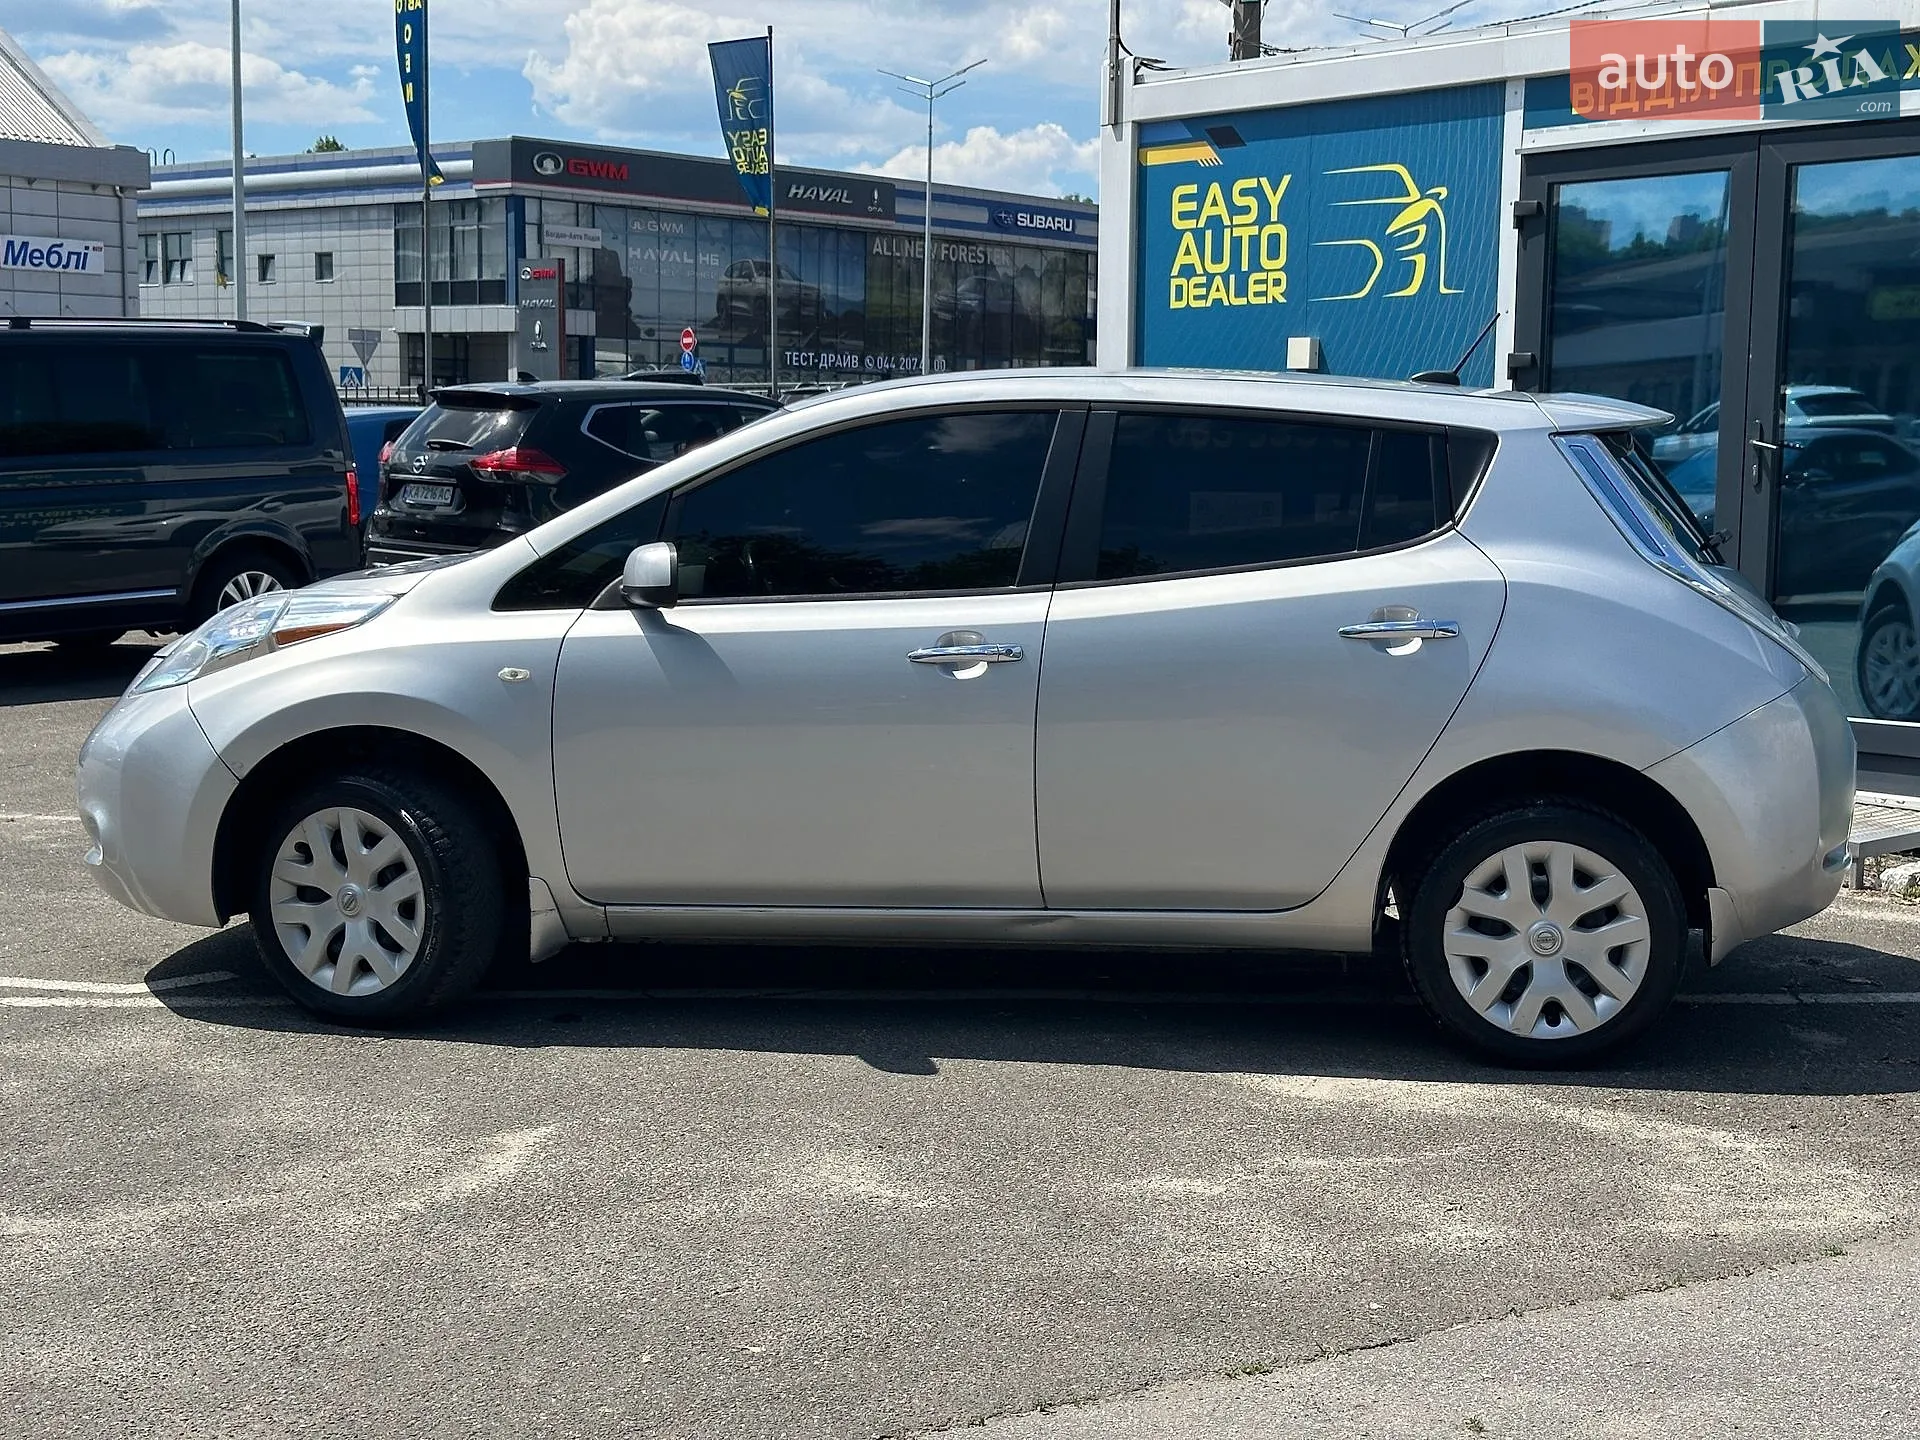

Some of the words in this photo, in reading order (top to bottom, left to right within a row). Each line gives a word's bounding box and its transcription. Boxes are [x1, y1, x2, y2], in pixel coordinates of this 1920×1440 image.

[567, 158, 629, 181] GWM
[787, 184, 853, 204] HAVAL
[1171, 174, 1292, 230] EASY
[647, 220, 684, 235] GWM
[1016, 212, 1074, 233] SUBARU
[3, 239, 90, 271] Меблі
[628, 246, 694, 264] HAVAL
[872, 236, 901, 257] ALL
[1169, 223, 1288, 276] AUTO
[1169, 271, 1288, 310] DEALER
[521, 298, 556, 309] HAVAL
[784, 351, 860, 369] ТЕСТ-ДРАЙВ
[876, 355, 896, 370] 044
[899, 356, 918, 371] 207
